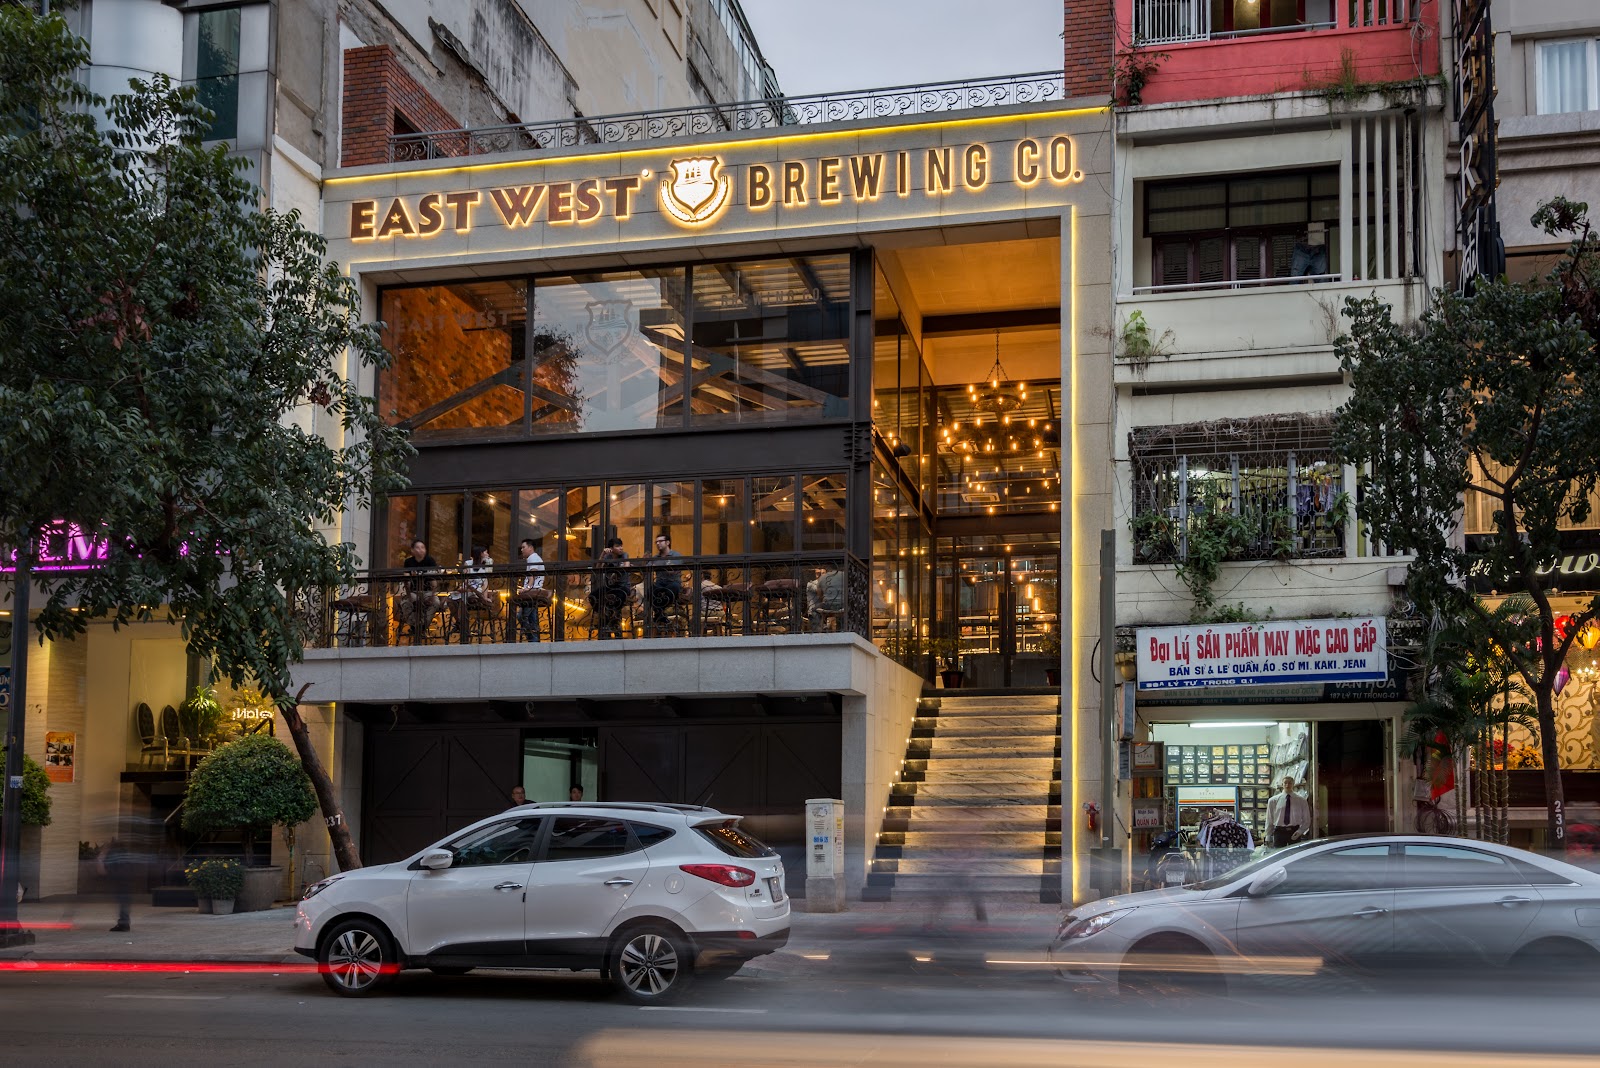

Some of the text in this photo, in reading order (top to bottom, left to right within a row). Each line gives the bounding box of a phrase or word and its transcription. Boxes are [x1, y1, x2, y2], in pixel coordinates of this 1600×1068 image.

[351, 136, 1083, 240] EAST WEST BREWING CO.
[1174, 634, 1190, 665] Lý
[1197, 628, 1220, 660] SẢN
[1225, 626, 1259, 658] PHẨM
[1264, 629, 1289, 656] MAY
[1295, 625, 1321, 657] MẶC
[1325, 627, 1349, 654] CAO
[1354, 619, 1377, 653] CẤP
[1169, 664, 1190, 676] BÁN
[1207, 665, 1214, 674] &
[1343, 659, 1366, 669] JEAN
[325, 813, 341, 827] 237
[1554, 799, 1564, 840] 239
